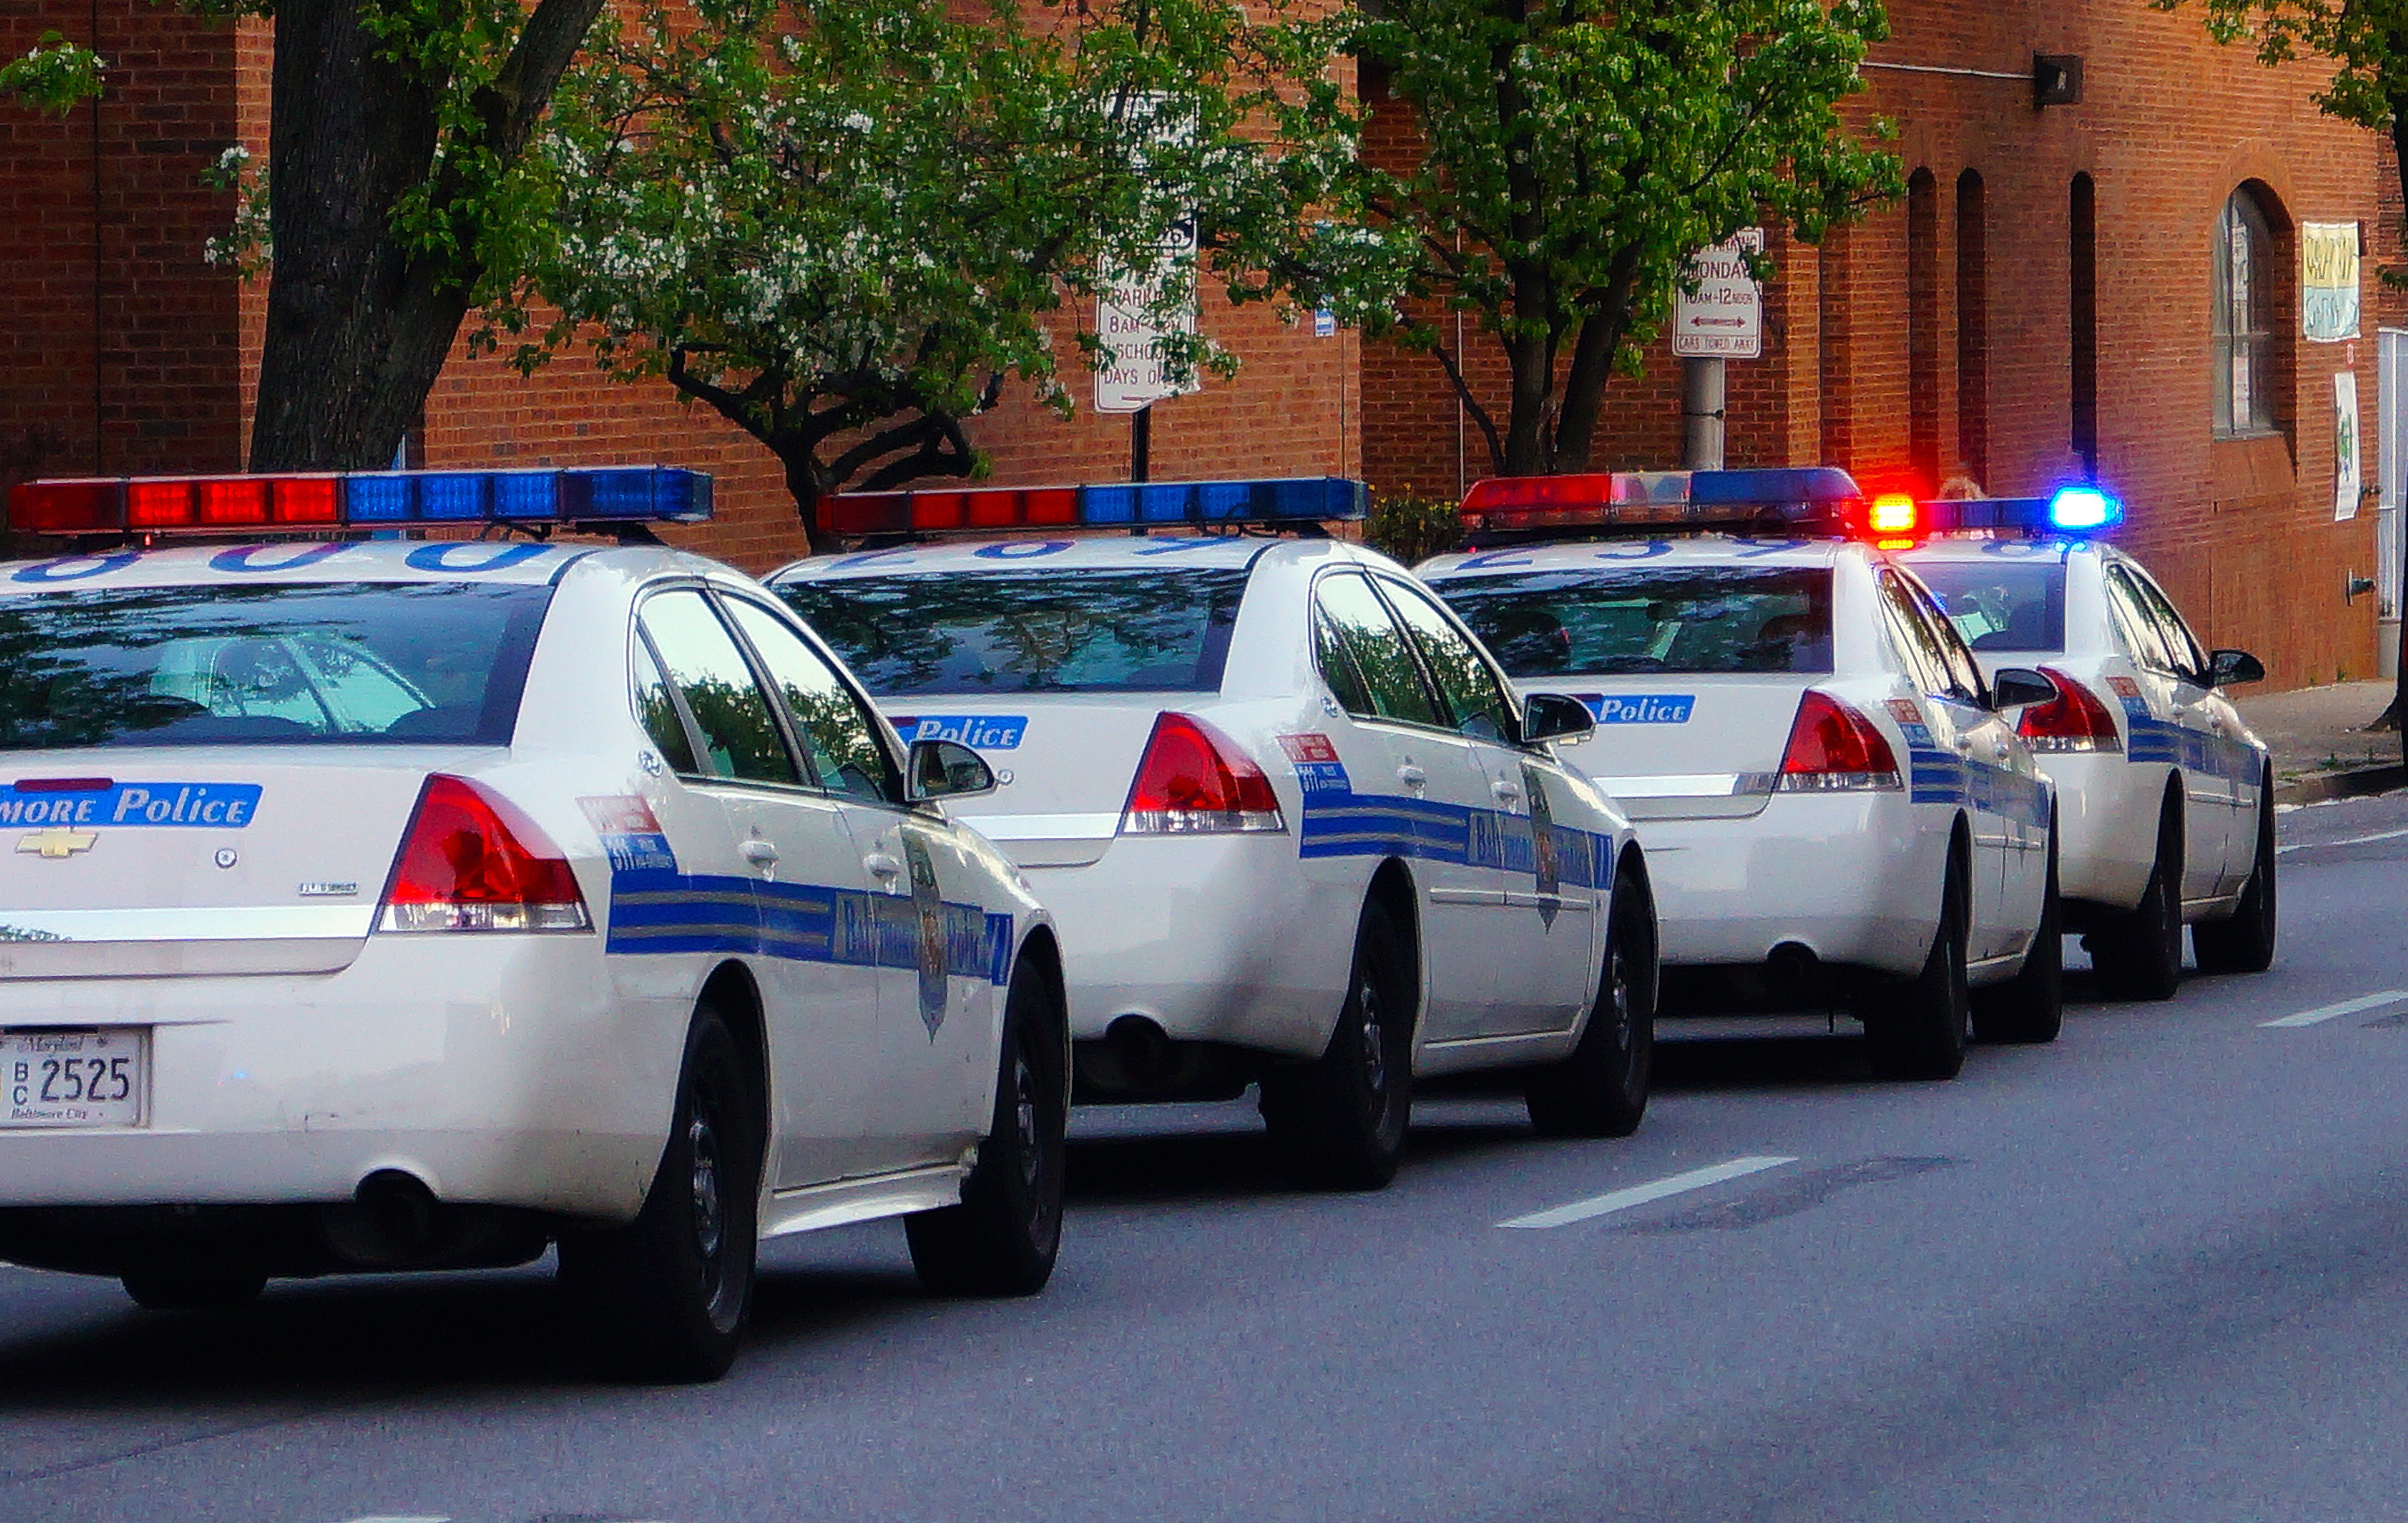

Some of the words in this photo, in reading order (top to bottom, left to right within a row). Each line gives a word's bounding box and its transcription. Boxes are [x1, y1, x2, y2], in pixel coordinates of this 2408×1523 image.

[1104, 368, 1139, 385] DAYS
[112, 787, 248, 823] Police
[40, 1057, 131, 1102] 2525
